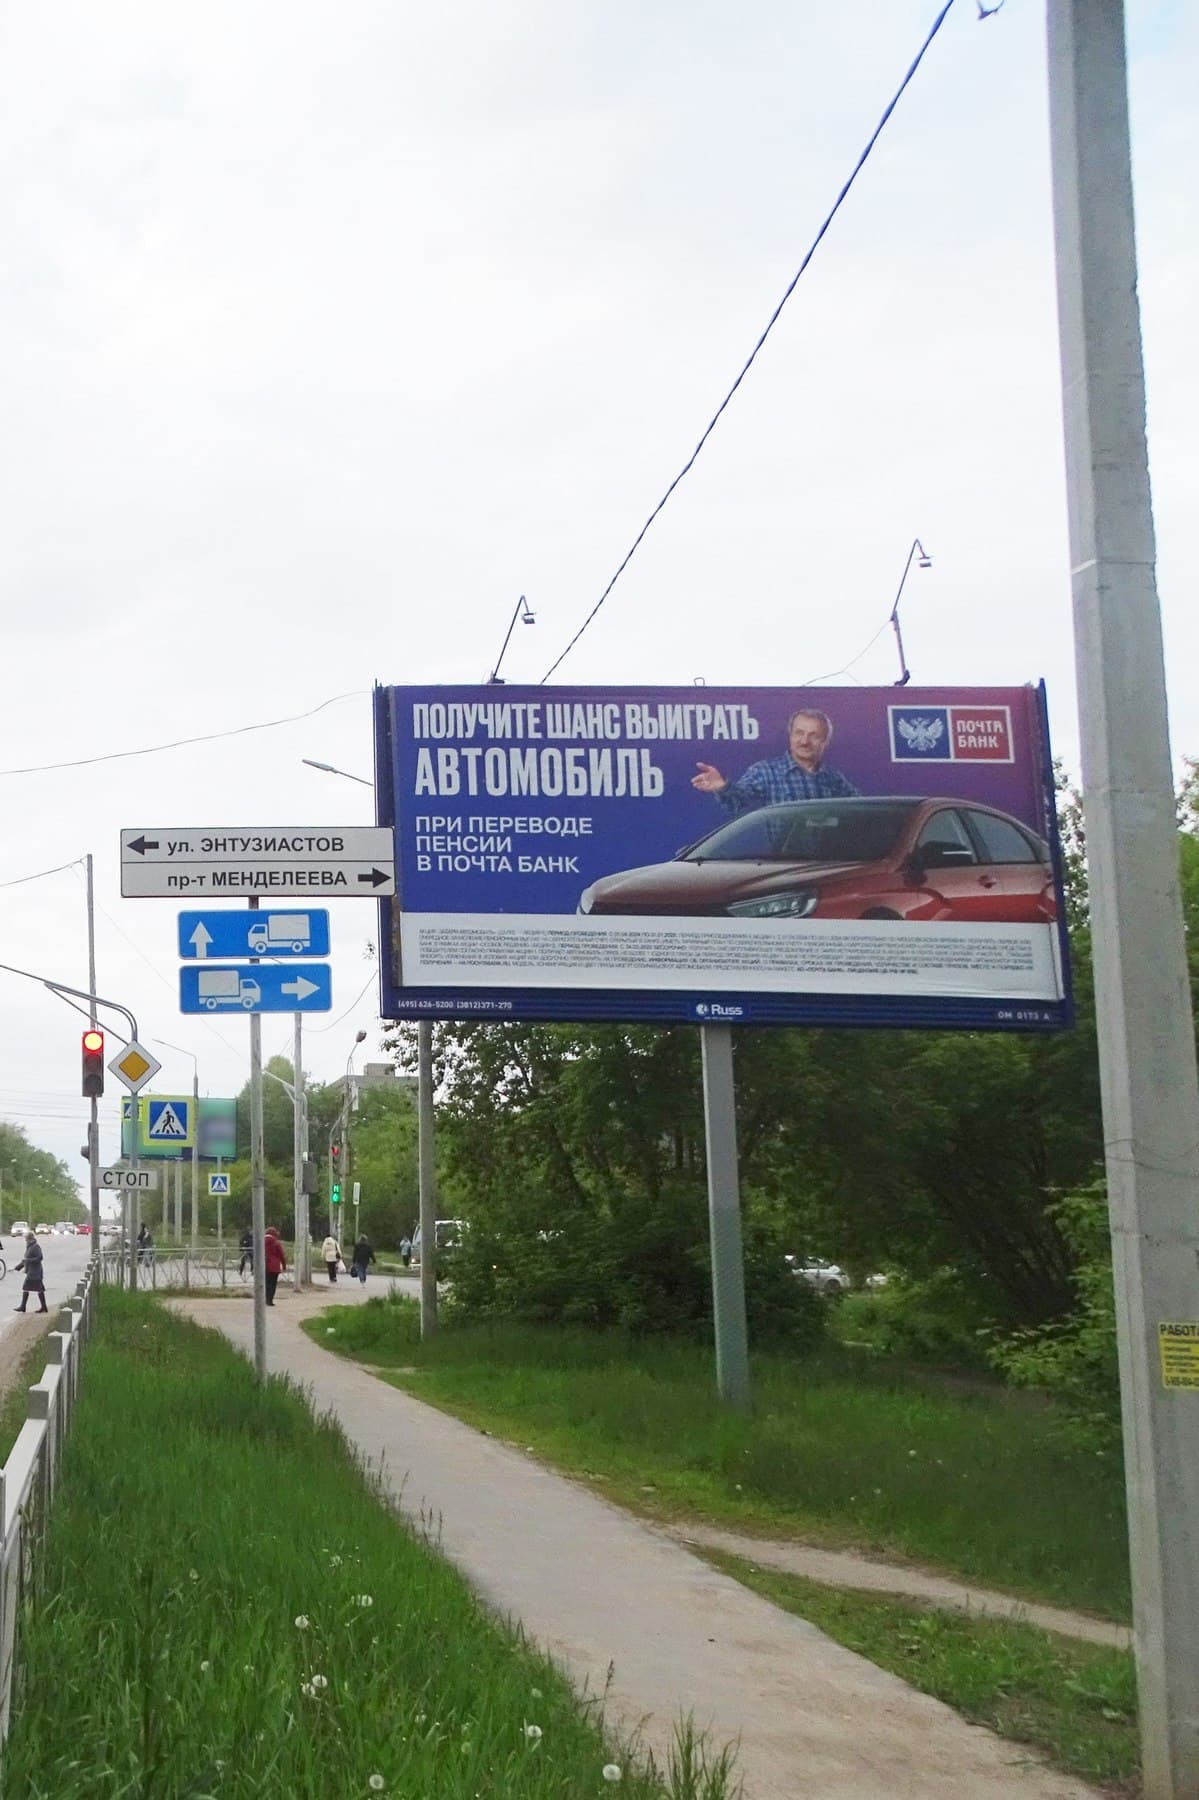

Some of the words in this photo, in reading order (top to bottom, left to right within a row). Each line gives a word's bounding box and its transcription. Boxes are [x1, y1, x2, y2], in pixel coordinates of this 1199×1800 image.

[413, 703, 542, 739] ПОЛУЧИТЕ
[546, 703, 621, 740] ШАНС
[625, 704, 760, 741] ВЫИГРАТЬ
[956, 720, 1004, 734] ПОЧТА
[958, 735, 999, 748] БАНК
[414, 747, 665, 798] АВТОМОБИЛЬ
[415, 816, 462, 834] ПРИ
[469, 816, 593, 836] ПЕРЕВОДЕ
[166, 840, 195, 857] ул.
[200, 837, 345, 853] ЭНТУЗИАСТОВ
[416, 836, 512, 853] ПЕНСИИ
[417, 856, 431, 872] В
[438, 856, 513, 873] ПОЧТА
[518, 855, 580, 873] БАНК
[167, 874, 206, 890] пр-т
[212, 871, 348, 888] МЕНДЕЛЕЕВА
[711, 1003, 744, 1016] Russ
[103, 1171, 149, 1186] СТОП
[1159, 1323, 1199, 1337] РАБОТ
